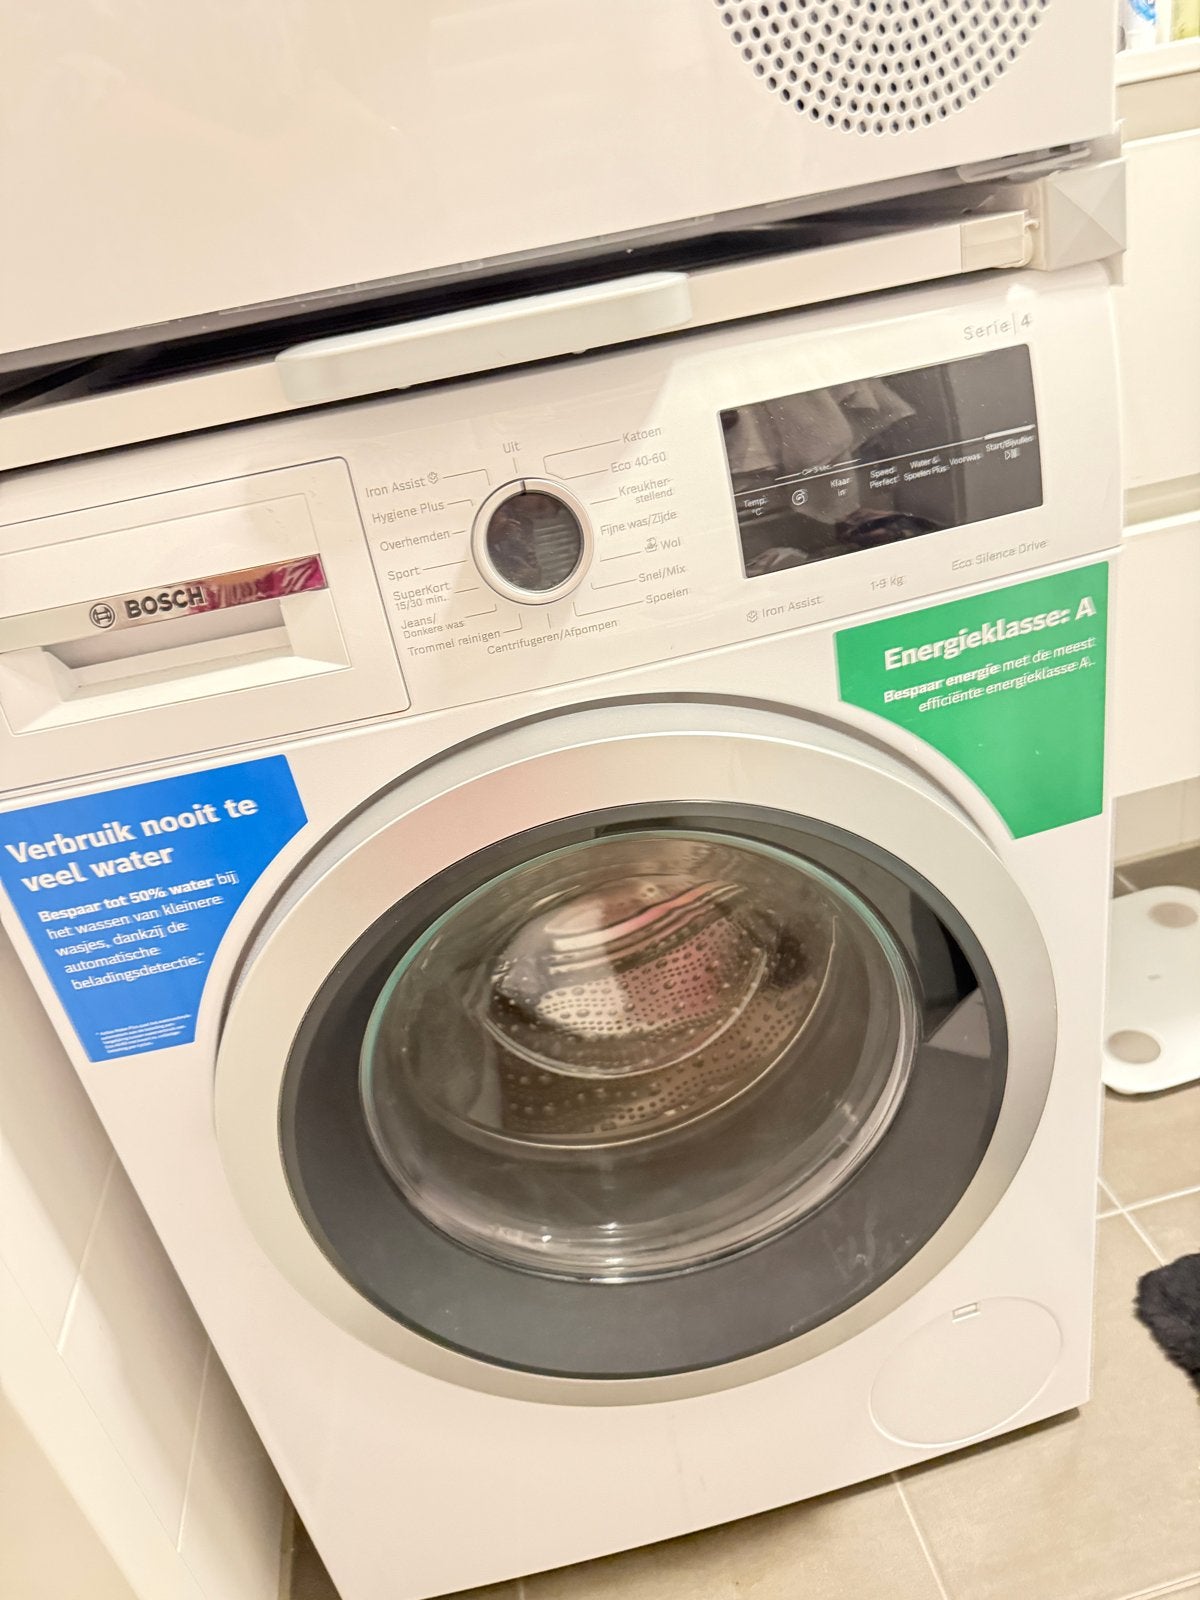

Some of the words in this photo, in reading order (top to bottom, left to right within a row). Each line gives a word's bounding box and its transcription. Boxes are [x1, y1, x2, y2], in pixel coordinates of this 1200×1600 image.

[622, 426, 662, 443] Katoen
[502, 441, 520, 454] Uit
[611, 460, 631, 473] Eco
[634, 451, 667, 467] 40-60
[909, 456, 931, 469] Water
[949, 453, 984, 466] Voorwas
[869, 475, 900, 489] Perfect
[870, 465, 896, 479] Speed
[365, 483, 389, 498] Iron
[391, 476, 426, 493] Assist
[618, 477, 673, 497] Kreukher-
[635, 488, 673, 504] stellend
[372, 504, 417, 524] Hygiene
[419, 499, 445, 513] Plus
[600, 521, 626, 536] Fijne
[627, 510, 678, 531] was/Zijde
[379, 528, 450, 552] Overhemden
[660, 537, 681, 550] Wol
[951, 557, 973, 571] Eco
[975, 549, 1015, 566] Silence
[1017, 538, 1048, 554] Drive
[388, 564, 421, 582] Sport
[638, 564, 687, 583] Snel/Mix
[870, 579, 887, 591] 1-9
[889, 575, 905, 589] kg
[124, 585, 205, 619] BOSCH
[393, 581, 451, 602] SuperKort
[395, 598, 423, 611] 15/30
[425, 594, 448, 606] min.
[645, 587, 690, 605] Spoelen
[761, 604, 785, 618] Iron
[787, 596, 821, 613] Assist
[401, 613, 436, 630] Jeans/
[403, 623, 444, 639] Donkere
[445, 619, 465, 631] was
[407, 640, 455, 657] Trommel
[457, 629, 501, 648] reinigen
[487, 618, 618, 655] Centrifugeren/Afpompen
[884, 606, 1071, 671] Energieklasse:
[1074, 596, 1097, 619] A
[884, 679, 945, 703] Bespaar
[946, 663, 1001, 686] energie
[1002, 655, 1030, 672] met
[1032, 650, 1052, 664] de
[1053, 637, 1096, 658] meest
[918, 687, 985, 713] efficiënte
[986, 662, 1078, 694] energieklasse
[1078, 656, 1095, 669] A.
[5, 819, 137, 864] Verbruik
[139, 803, 221, 838] nooit
[224, 798, 259, 819] te
[20, 862, 88, 893] veel
[90, 846, 175, 879] water
[38, 899, 102, 923] Bespaar
[103, 896, 129, 910] tot
[129, 886, 168, 905] 50%
[168, 877, 215, 897] water
[216, 870, 240, 886] bij
[46, 926, 75, 940] het
[75, 914, 131, 936] wassen
[132, 908, 161, 923] van
[162, 894, 224, 916] kleinere
[55, 939, 112, 958] wasjes,
[112, 925, 166, 947] dankzij
[167, 919, 189, 935] de
[64, 945, 162, 975] automatische
